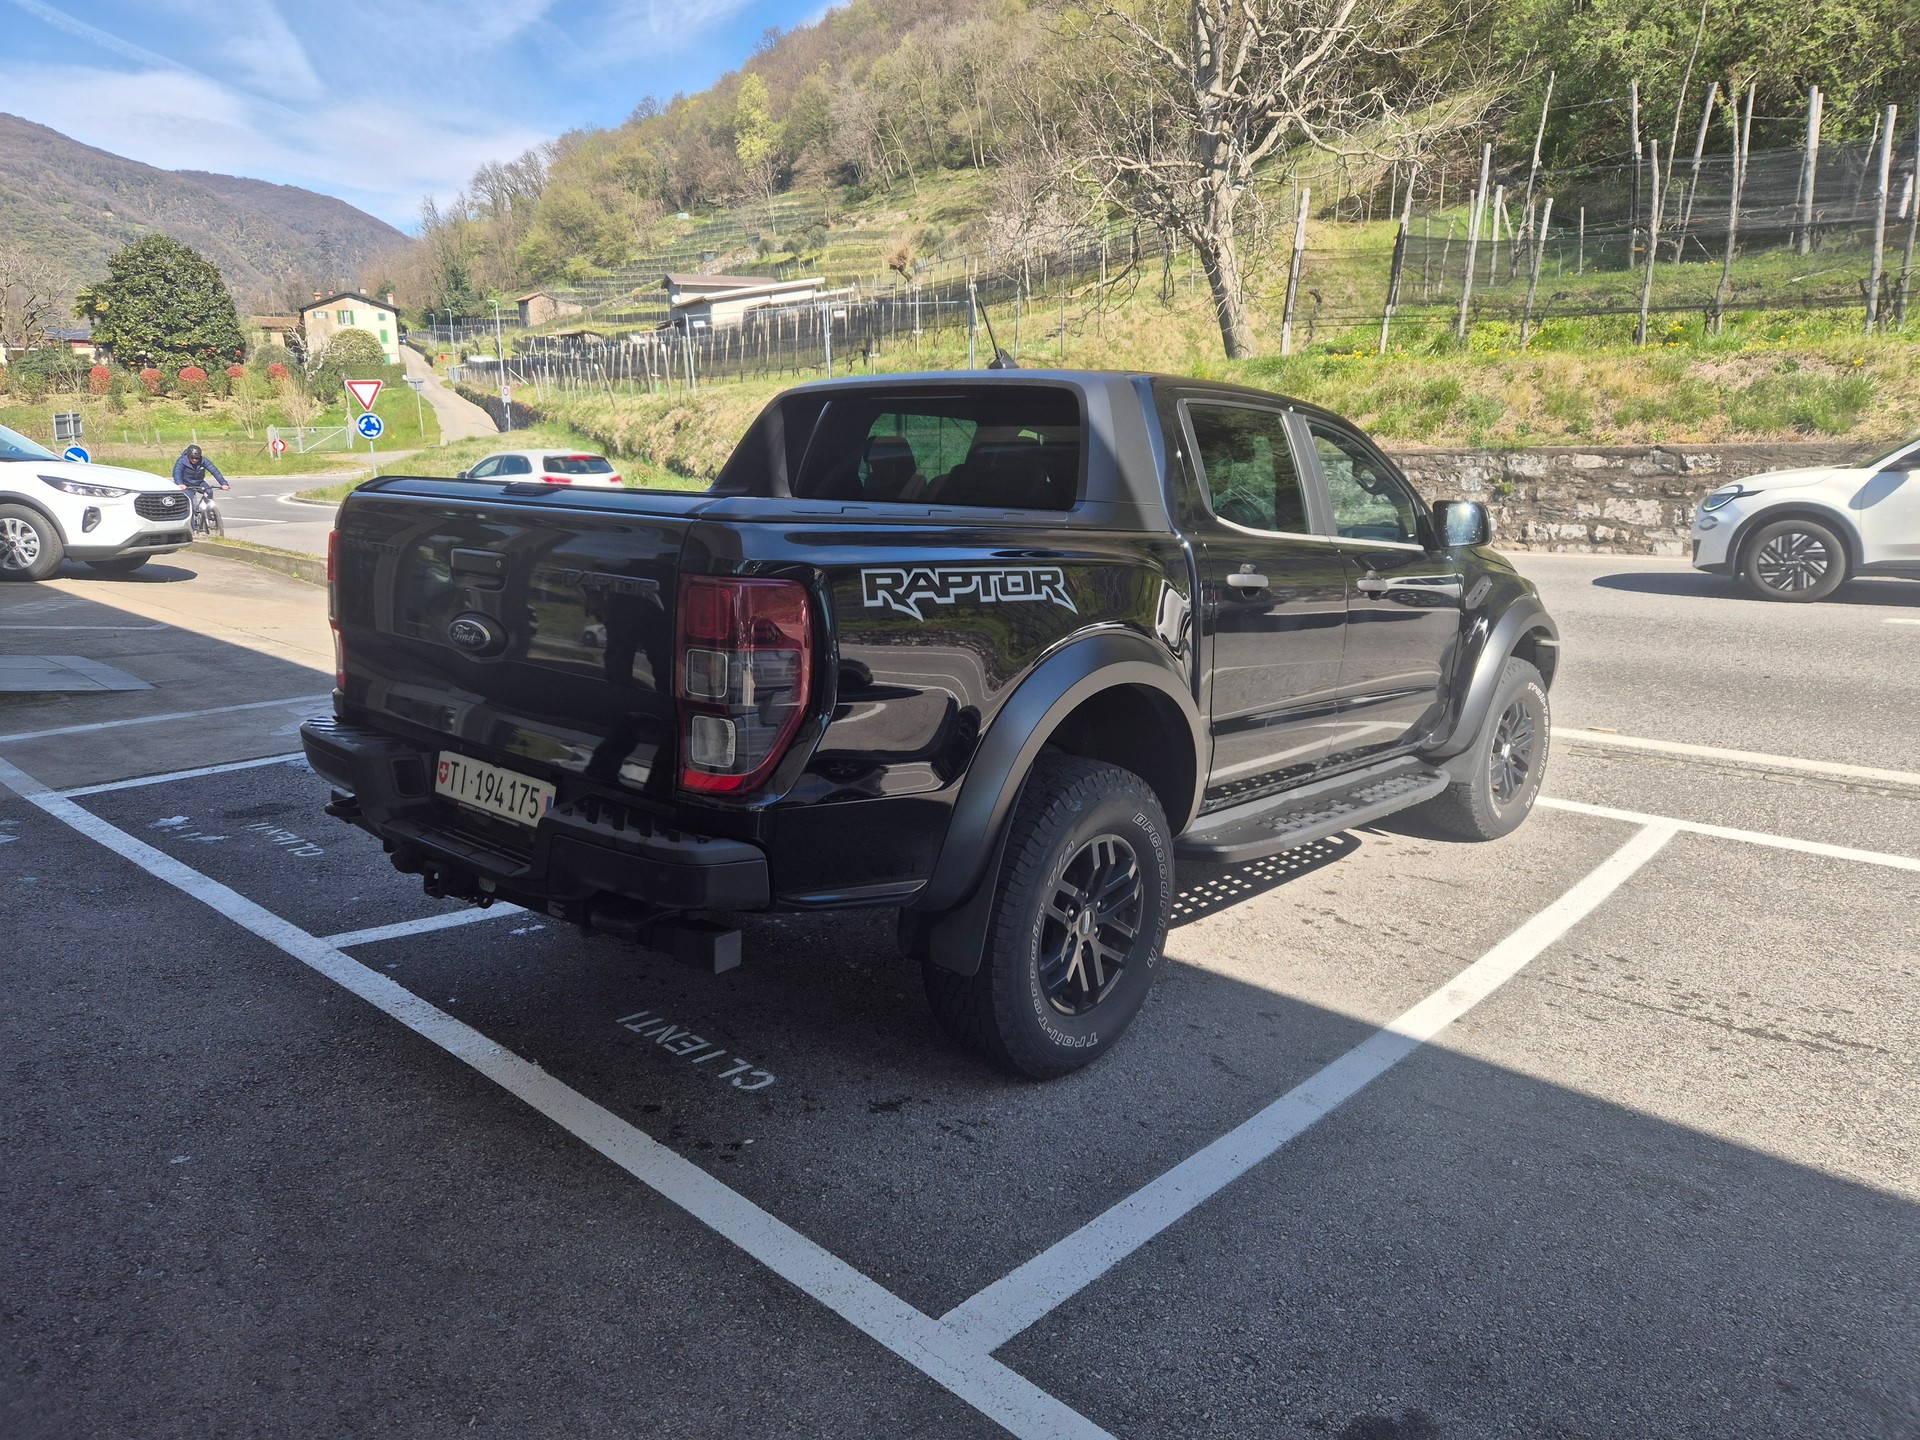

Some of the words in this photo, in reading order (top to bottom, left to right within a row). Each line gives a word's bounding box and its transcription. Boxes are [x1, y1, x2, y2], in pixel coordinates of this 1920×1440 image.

[861, 567, 1078, 622] RAPTOR
[453, 624, 481, 644] Ford
[1047, 840, 1075, 888] T/A
[1132, 812, 1168, 969] BFGoodrich
[616, 1010, 776, 1089] CLIENTI
